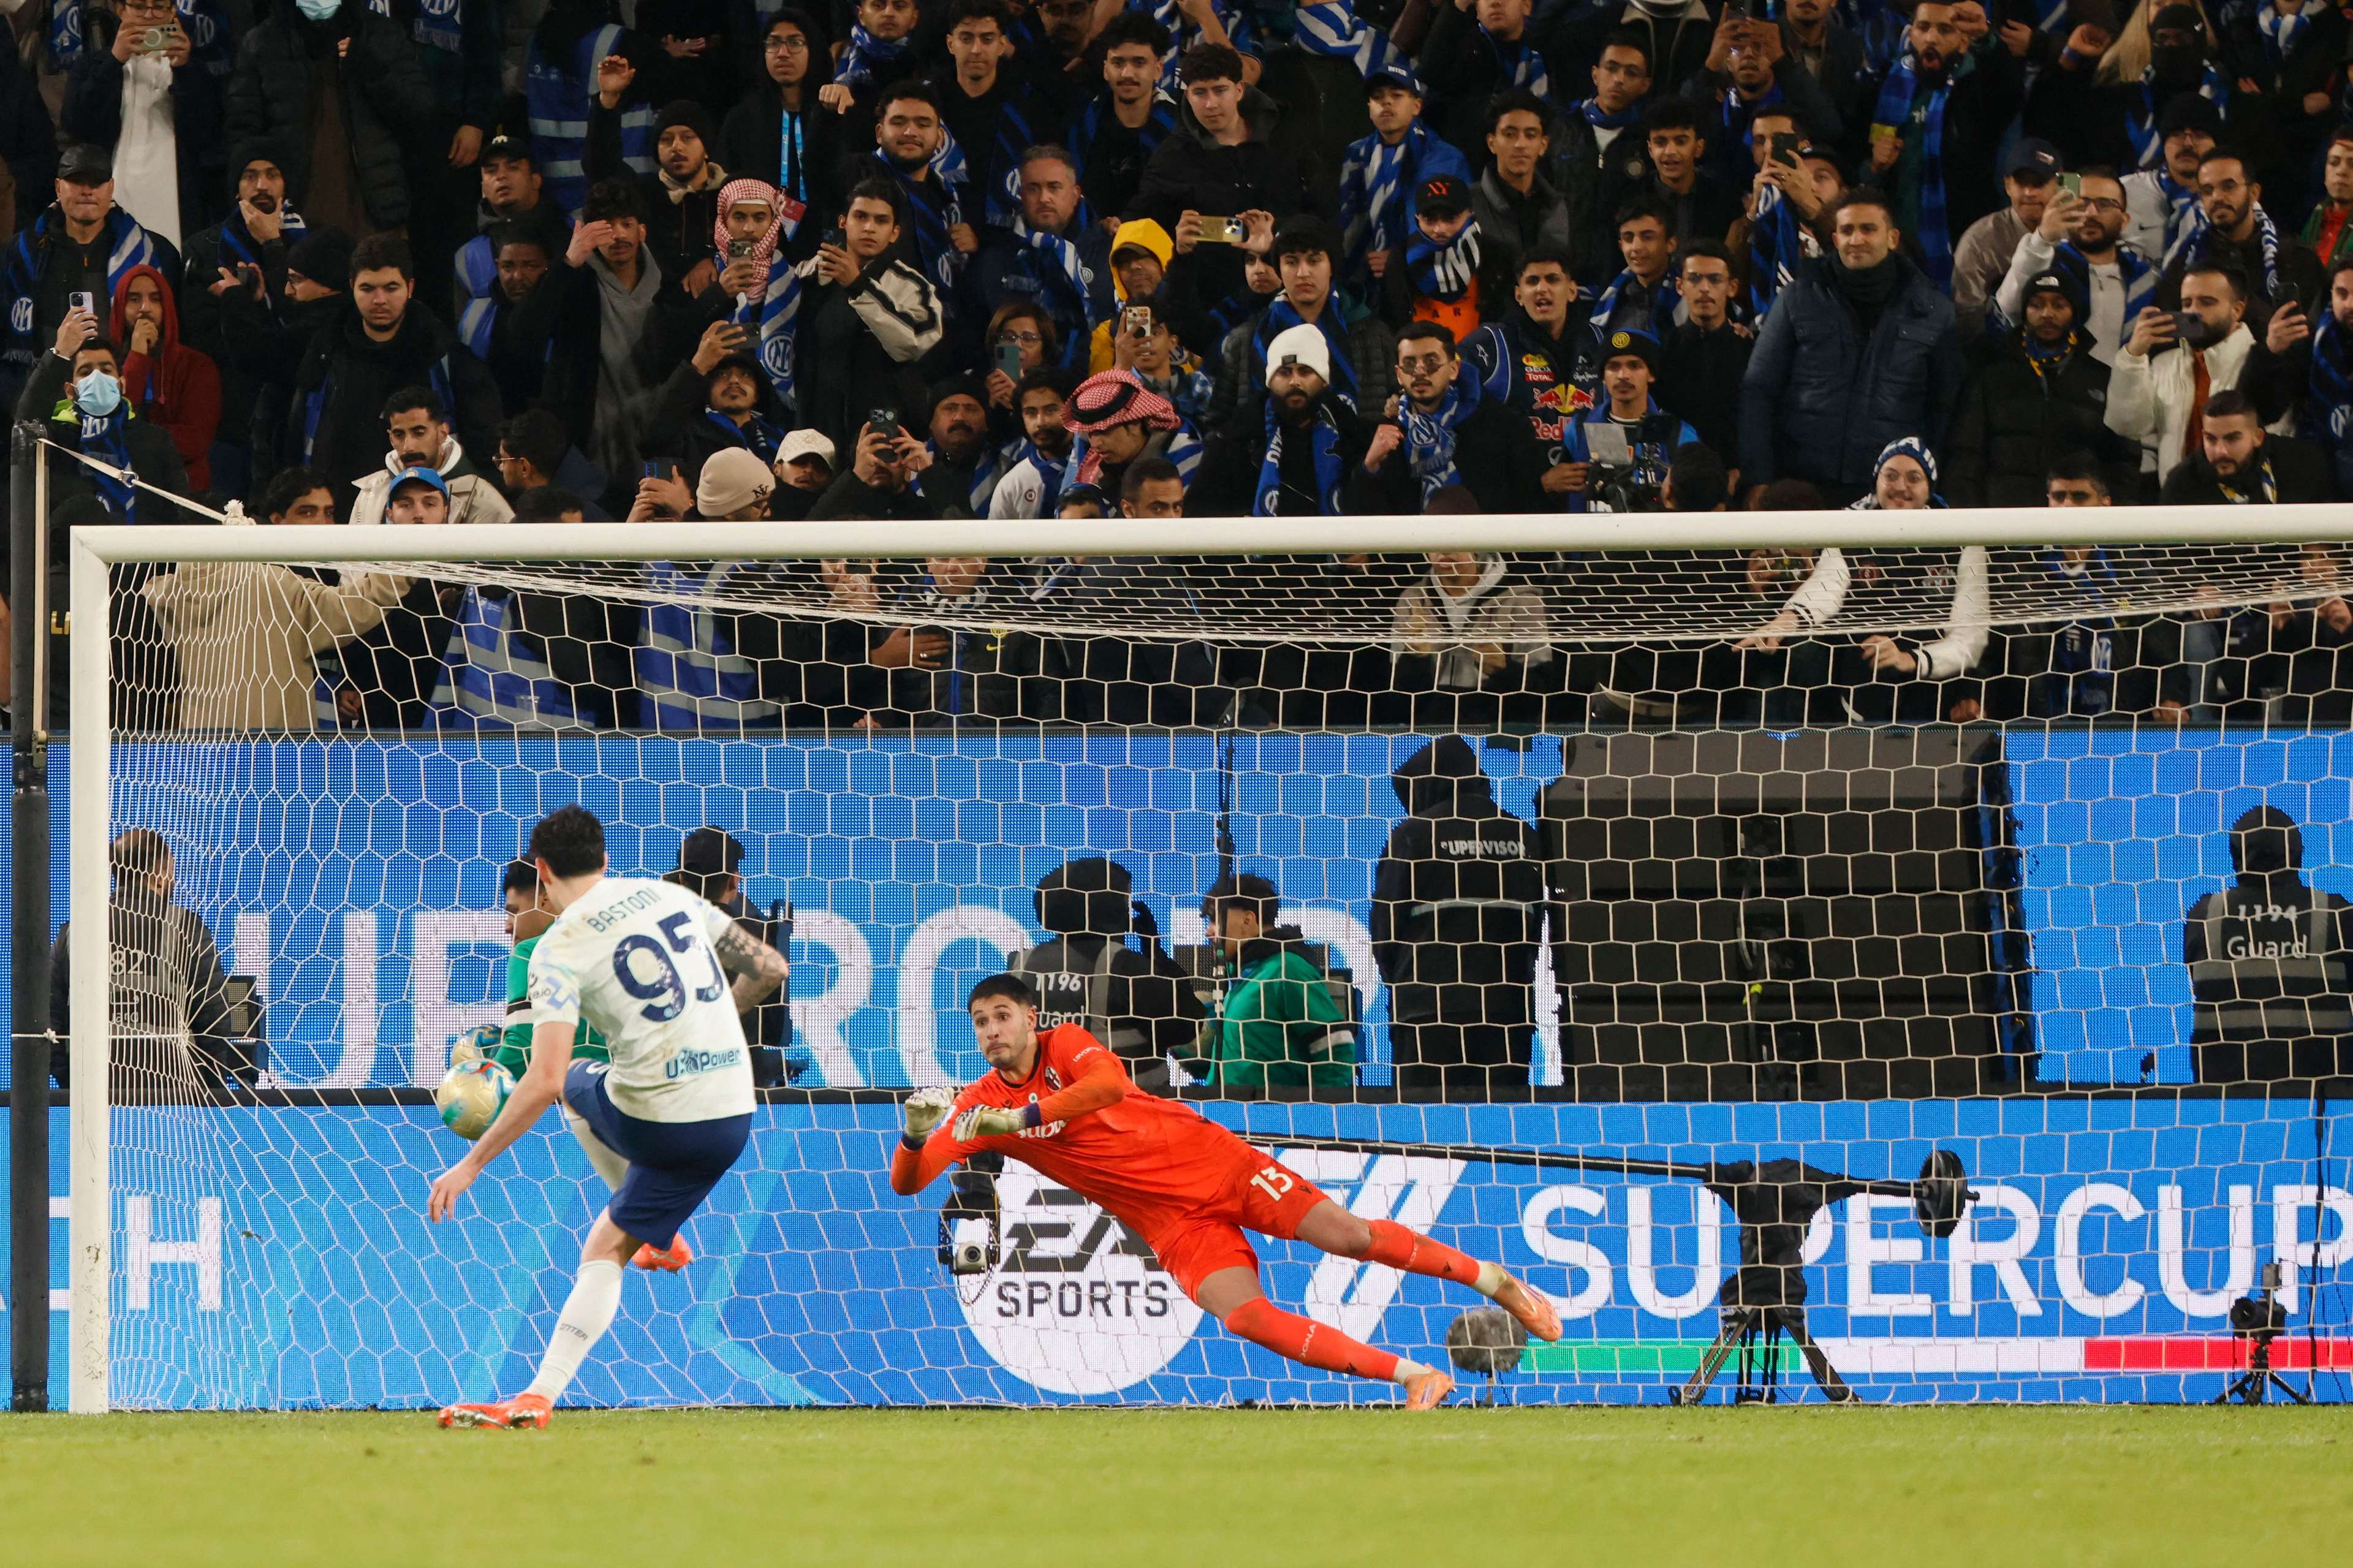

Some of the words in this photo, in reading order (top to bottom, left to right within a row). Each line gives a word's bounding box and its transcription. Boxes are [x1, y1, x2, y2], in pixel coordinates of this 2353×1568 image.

[587, 888, 662, 933] BASTONI
[2237, 904, 2298, 922] 1194
[2227, 934, 2308, 960] Guard
[612, 911, 724, 1023] 95
[1036, 973, 1082, 991] 1196
[1033, 1005, 1085, 1029] uard
[1250, 1166, 1293, 1202] 13
[1523, 1183, 2353, 1319] SUERCUP
[996, 1281, 1169, 1318] SPORTS
